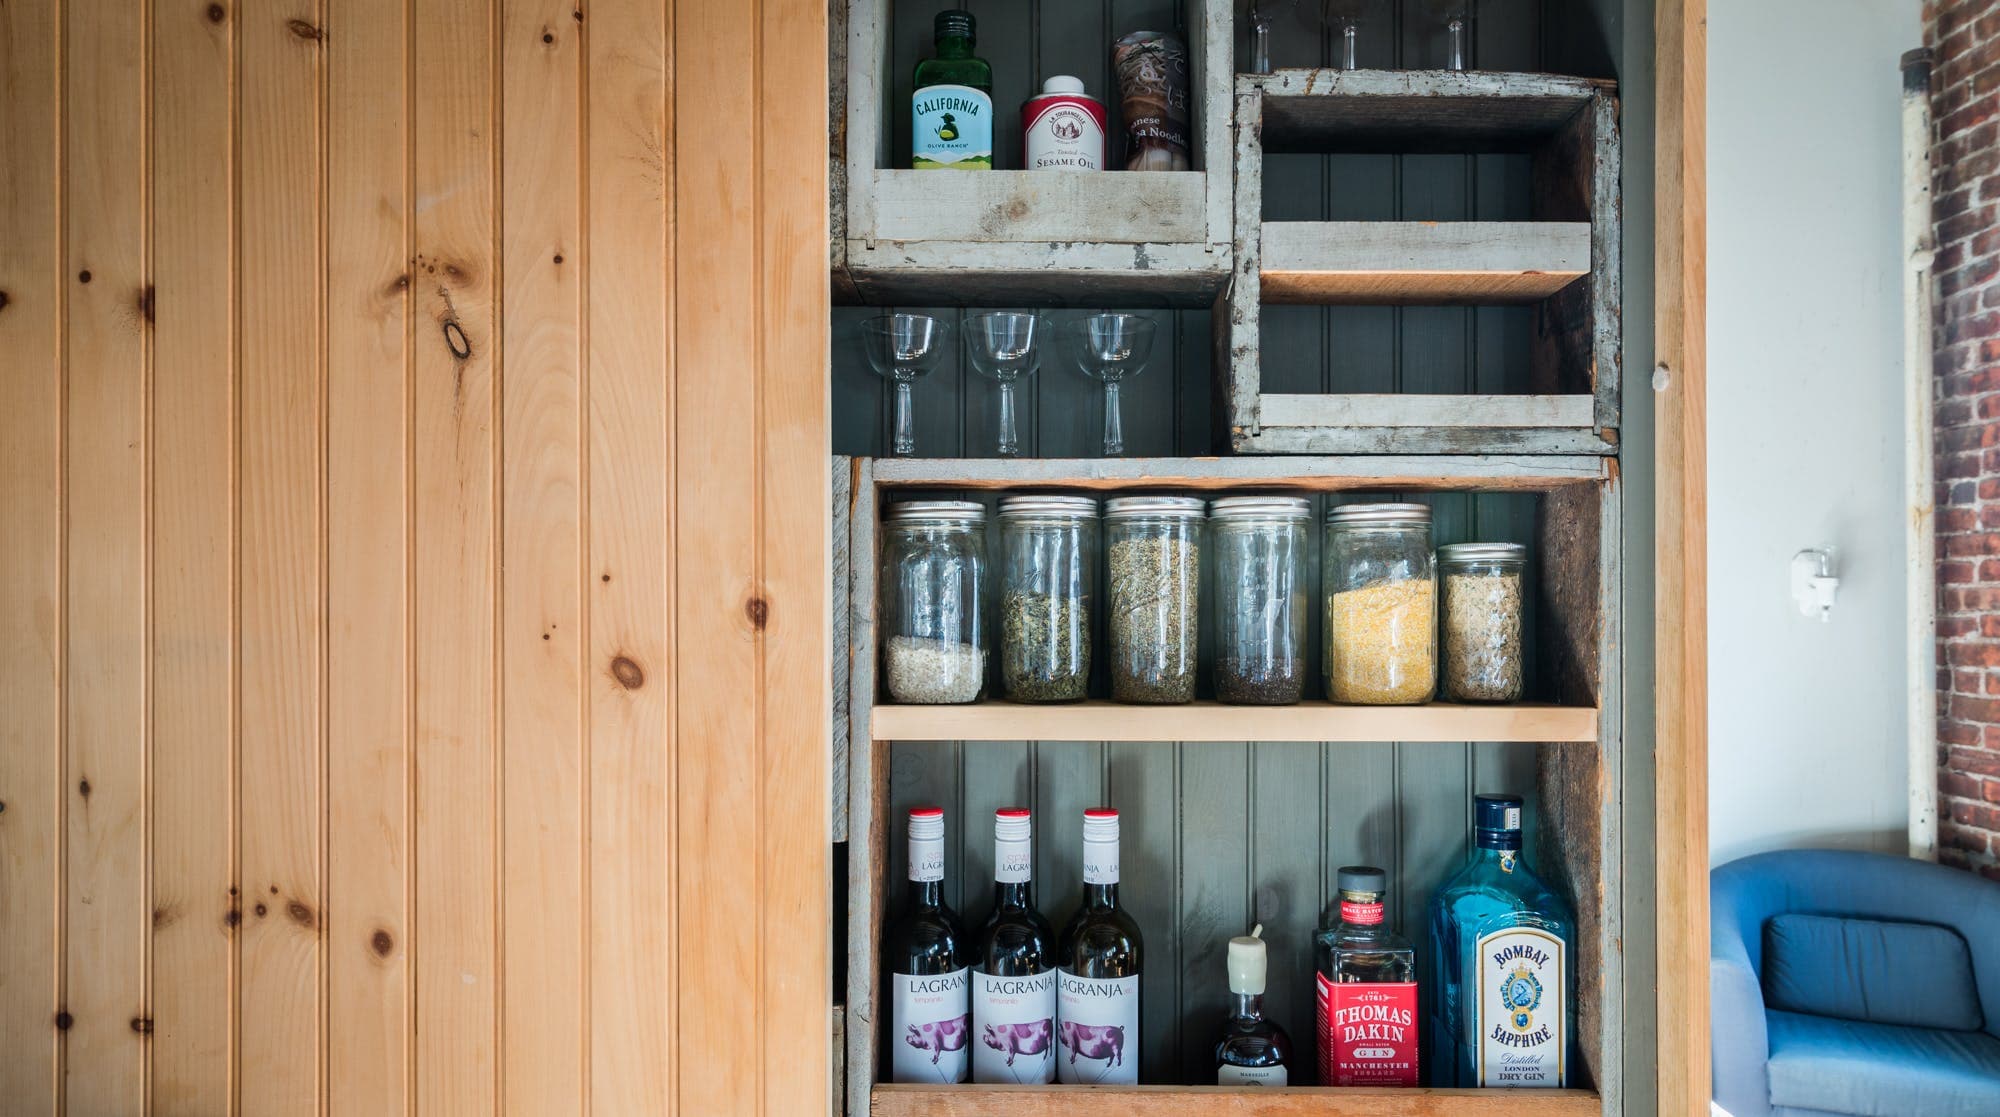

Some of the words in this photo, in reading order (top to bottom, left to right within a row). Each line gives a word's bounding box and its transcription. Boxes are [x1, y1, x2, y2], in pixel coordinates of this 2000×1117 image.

[916, 97, 980, 116] CALIFORNIA
[1036, 158, 1075, 169] SESAME
[1078, 157, 1096, 170] OIL
[1493, 944, 1550, 970] BOMBAY
[986, 976, 1053, 995] LAGRANJA
[1059, 975, 1123, 998] LAGRANJA
[1336, 1004, 1412, 1026] THOMAS
[1343, 1023, 1405, 1043] DAKIN
[1490, 1023, 1553, 1048] SAPPHIRE
[1359, 1049, 1390, 1057] GIN
[1500, 1052, 1545, 1065] Distilled
[1498, 1072, 1522, 1081] DRY
[1523, 1072, 1546, 1081] GIN
